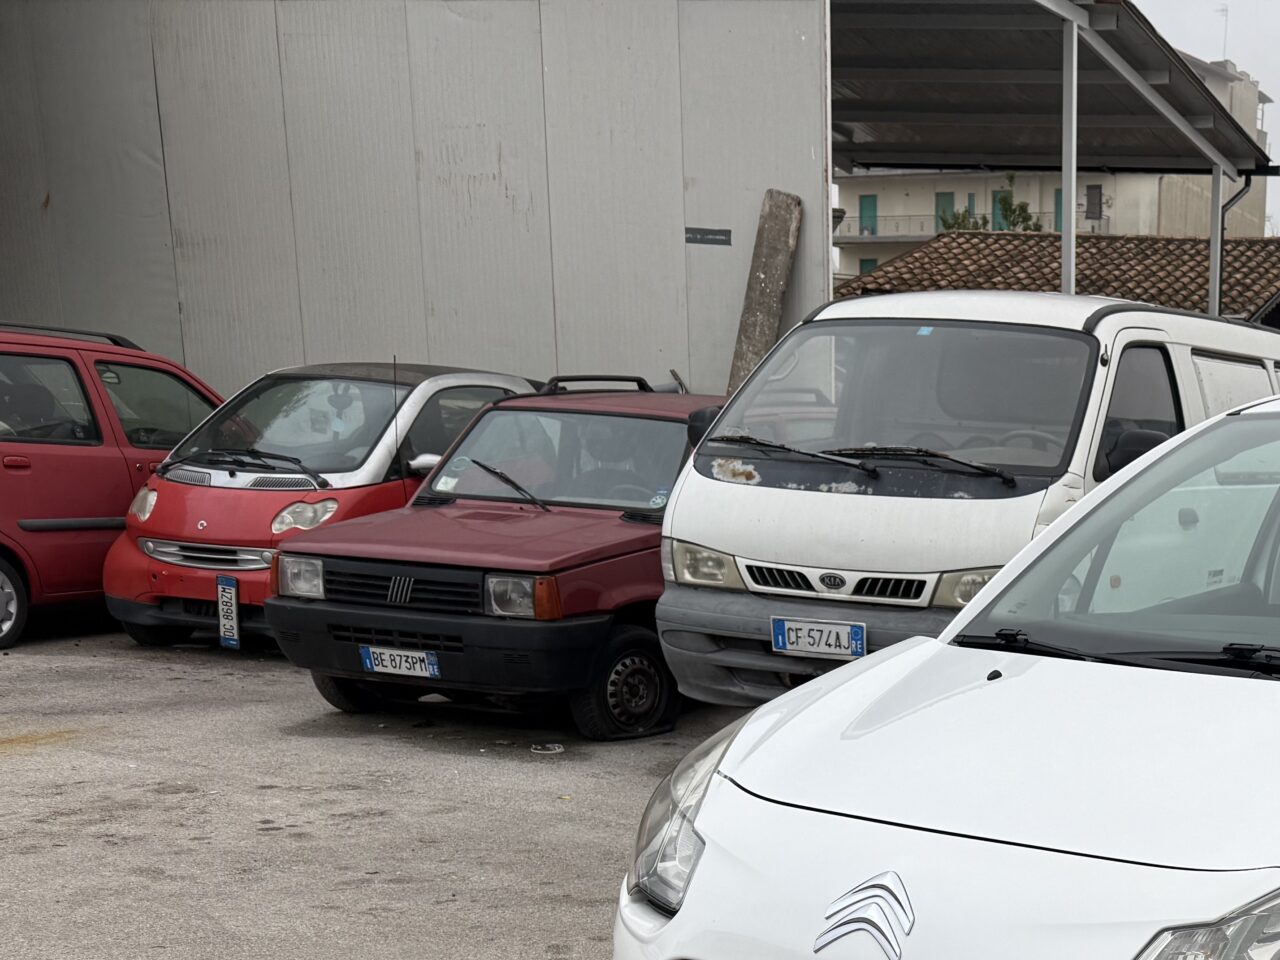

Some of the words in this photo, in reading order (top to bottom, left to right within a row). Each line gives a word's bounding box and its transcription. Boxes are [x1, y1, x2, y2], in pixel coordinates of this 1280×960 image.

[824, 576, 841, 585] KIA
[221, 586, 234, 621] 868ZM
[223, 623, 235, 638] DG
[786, 626, 803, 646] CF
[807, 628, 851, 650] 574AJ
[371, 651, 388, 668] BE
[389, 653, 428, 672] 873PM
